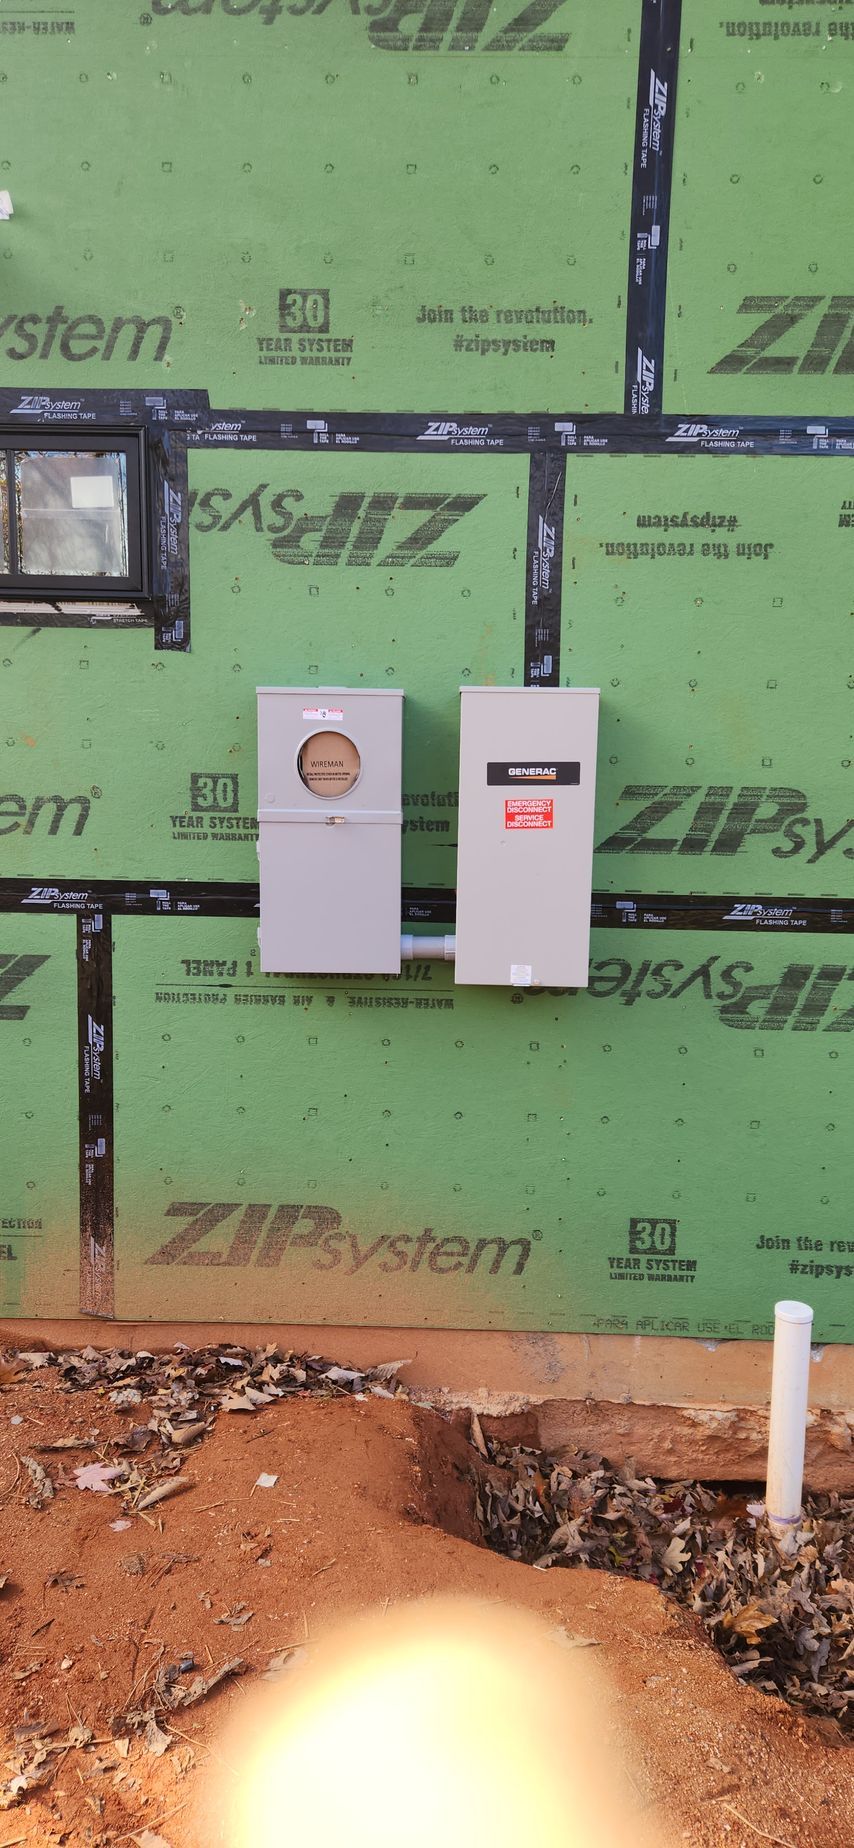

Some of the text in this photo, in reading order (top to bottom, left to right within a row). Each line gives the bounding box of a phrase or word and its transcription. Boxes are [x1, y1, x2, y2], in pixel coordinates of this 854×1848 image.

[719, 21, 821, 40] revolution.
[640, 108, 650, 169] FLASHING TAPE
[284, 292, 325, 328] 30
[415, 304, 594, 325] Join the revolution.
[256, 337, 354, 353] YEAR SYSTEM
[452, 333, 556, 357] #zipsystem
[258, 355, 352, 367] LIMITED WARRANTY
[640, 355, 655, 414] ZIPsyste
[43, 412, 97, 421] FLASHING TAPE
[204, 433, 257, 443] FLASHING TAPE
[450, 438, 504, 447] FLASHING TAPE
[700, 440, 755, 449] FLASHING TAPE
[636, 511, 738, 533] #zipsystem
[598, 540, 775, 560] Join the revolution.
[531, 551, 539, 587] FLASHING
[310, 760, 345, 769] WIREMAN
[508, 767, 557, 776] GENERAC
[196, 777, 234, 808] 30
[169, 815, 204, 829] YEAR
[595, 784, 854, 865] ZIPsy
[172, 831, 209, 841] LIMITED
[53, 902, 86, 910] FLASHING
[755, 919, 807, 927] FLASHING TAPE
[181, 959, 237, 977] PANEL
[155, 991, 228, 1005] PROTECTION
[233, 992, 286, 1007] BARRIER
[292, 994, 314, 1007] AIR
[347, 995, 455, 1010] WATER-RESISTIVE
[83, 1045, 91, 1093] FLASHING TAPE
[634, 1221, 672, 1250] 30
[755, 1234, 791, 1251] Join
[796, 1235, 824, 1252] the
[607, 1256, 698, 1272] YEAR SYSTEM
[609, 1272, 696, 1283] LIMITED WARRANTY
[635, 1319, 690, 1333] APLICAR
[697, 1321, 721, 1334] USE
